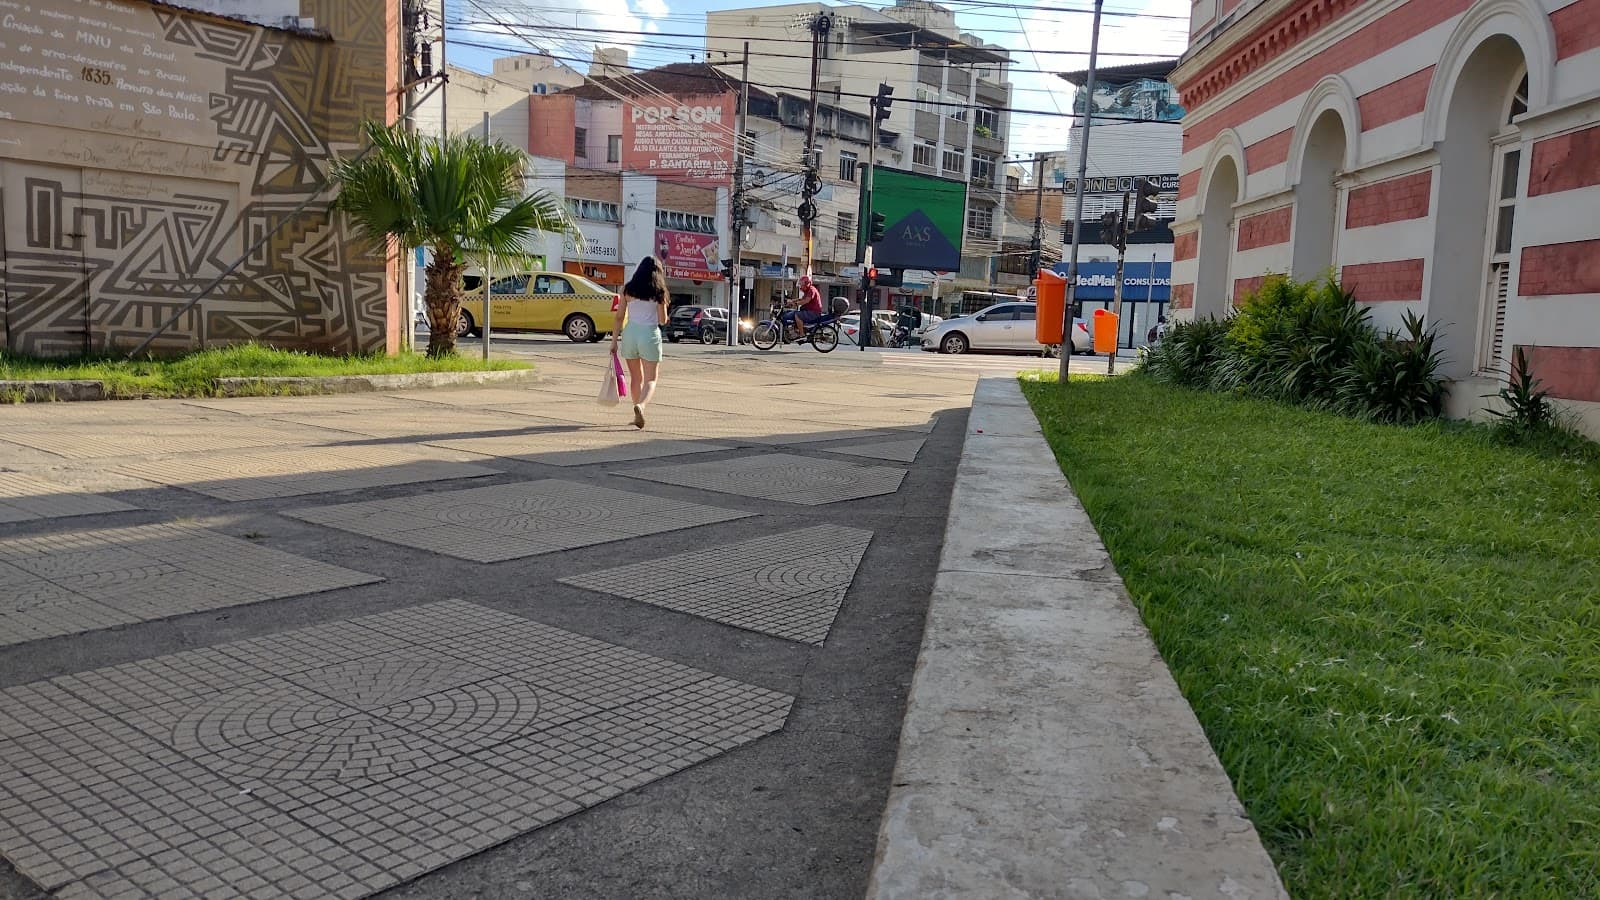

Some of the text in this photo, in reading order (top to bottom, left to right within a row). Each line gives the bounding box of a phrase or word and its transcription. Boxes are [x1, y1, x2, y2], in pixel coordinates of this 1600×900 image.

[76, 30, 112, 49] MNU
[120, 102, 135, 112] em
[142, 101, 162, 115] São
[632, 105, 721, 124] POP SOM
[661, 160, 692, 168] SANTA
[903, 224, 931, 242] AXS
[1124, 278, 1171, 286] CONSULTAS
